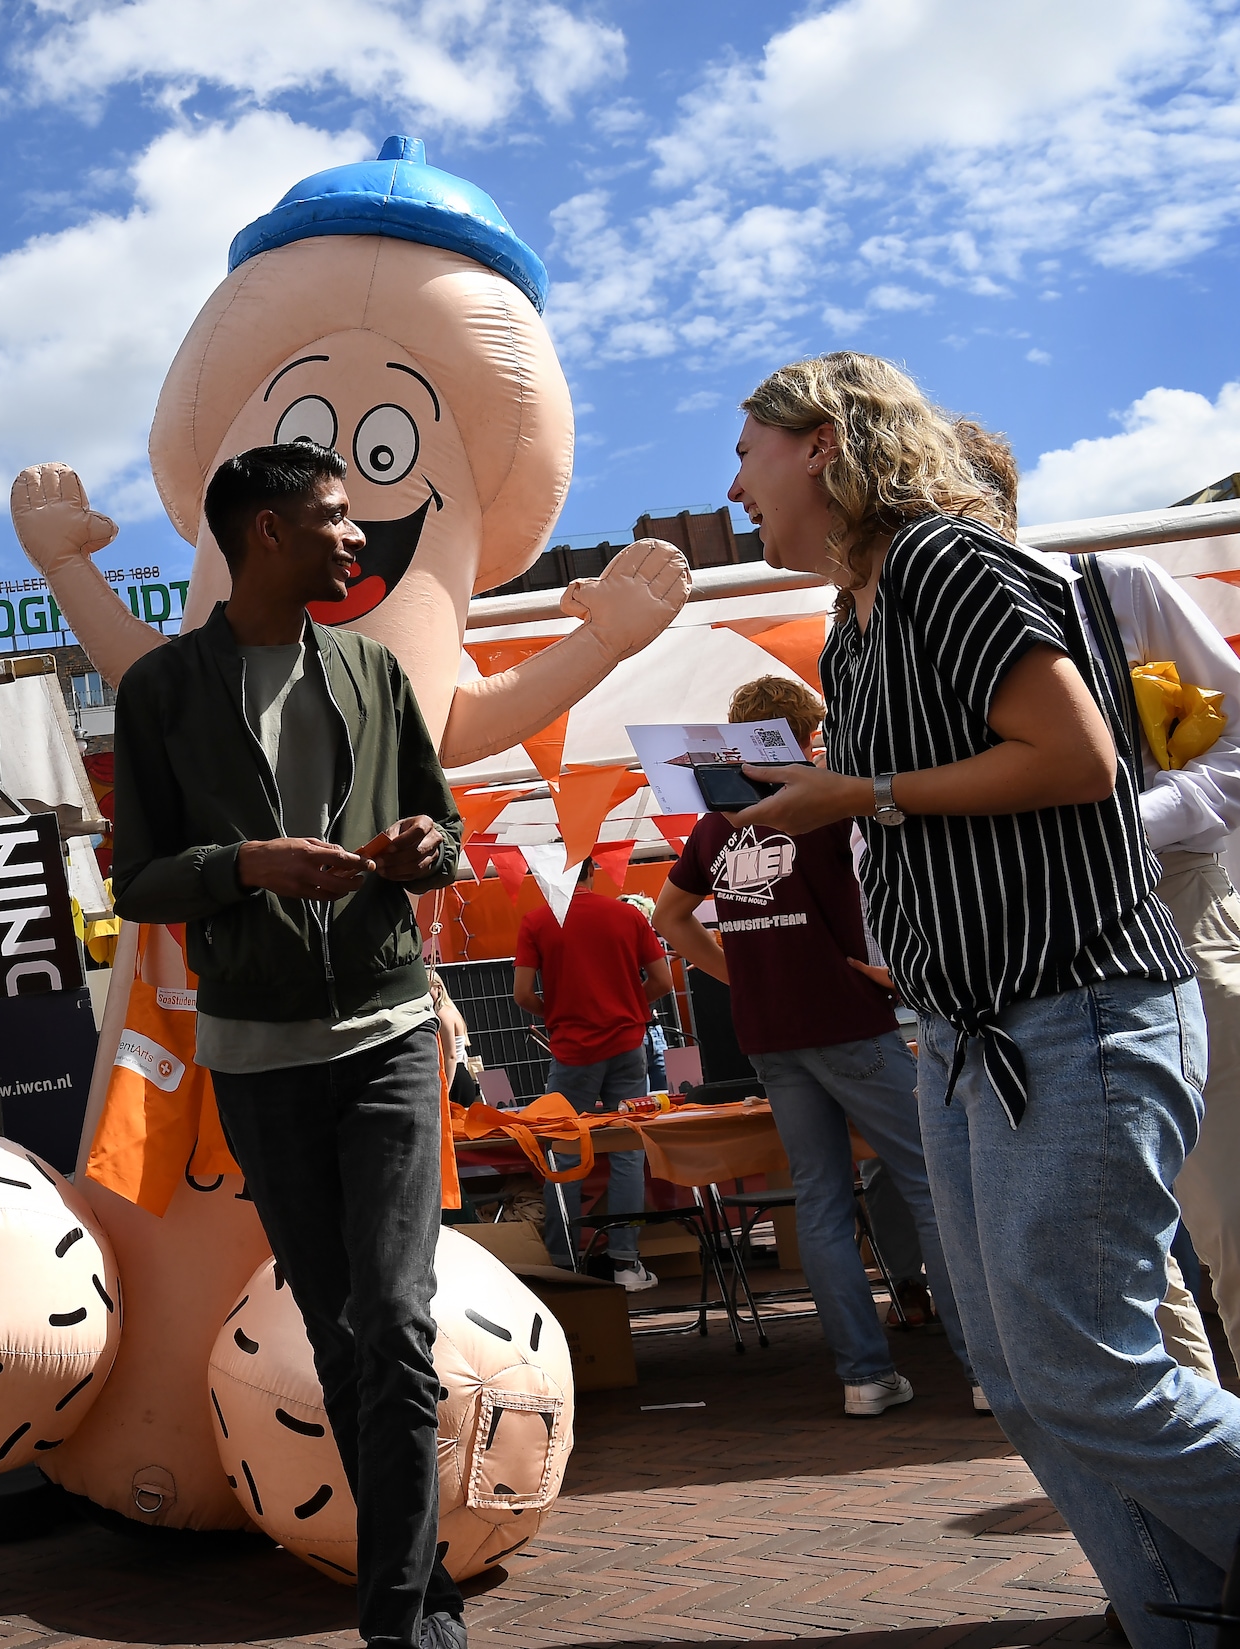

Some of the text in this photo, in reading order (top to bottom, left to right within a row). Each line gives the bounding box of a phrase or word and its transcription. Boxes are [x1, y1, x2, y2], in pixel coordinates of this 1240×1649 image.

[129, 566, 160, 580] 1888
[710, 832, 739, 875] SHAPE OF
[735, 895, 747, 904] THE
[748, 898, 768, 906] MOULD
